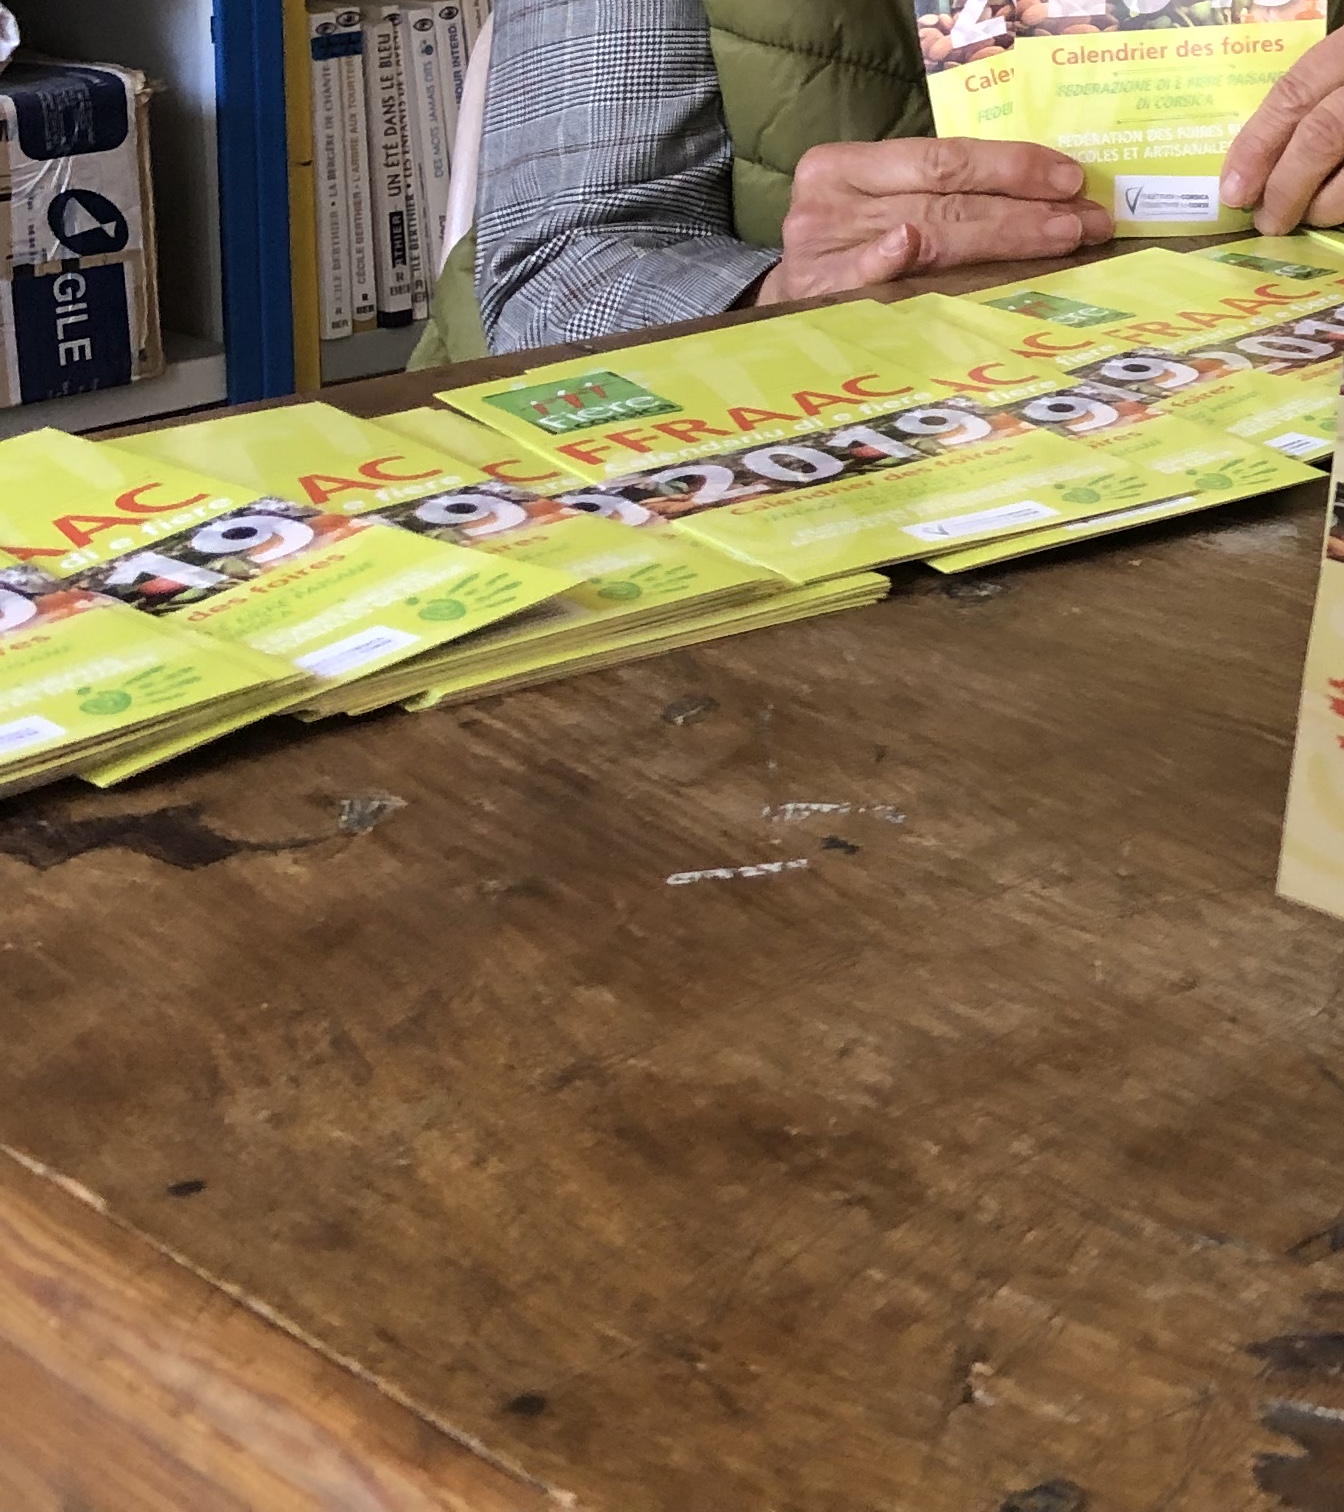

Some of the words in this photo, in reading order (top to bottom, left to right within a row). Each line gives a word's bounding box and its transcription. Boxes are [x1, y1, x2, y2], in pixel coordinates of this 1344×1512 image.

[378, 32, 392, 68] BLEU
[1050, 39, 1168, 68] Calendrier
[1175, 38, 1214, 59] des
[1220, 35, 1285, 56] foires
[380, 74, 395, 89] LE
[381, 93, 397, 136] DANS
[383, 141, 400, 168] ÉTÉ
[387, 178, 402, 197] UN
[537, 393, 664, 433] Fiere
[556, 373, 915, 466] FFRAAC
[650, 406, 994, 506] 2019
